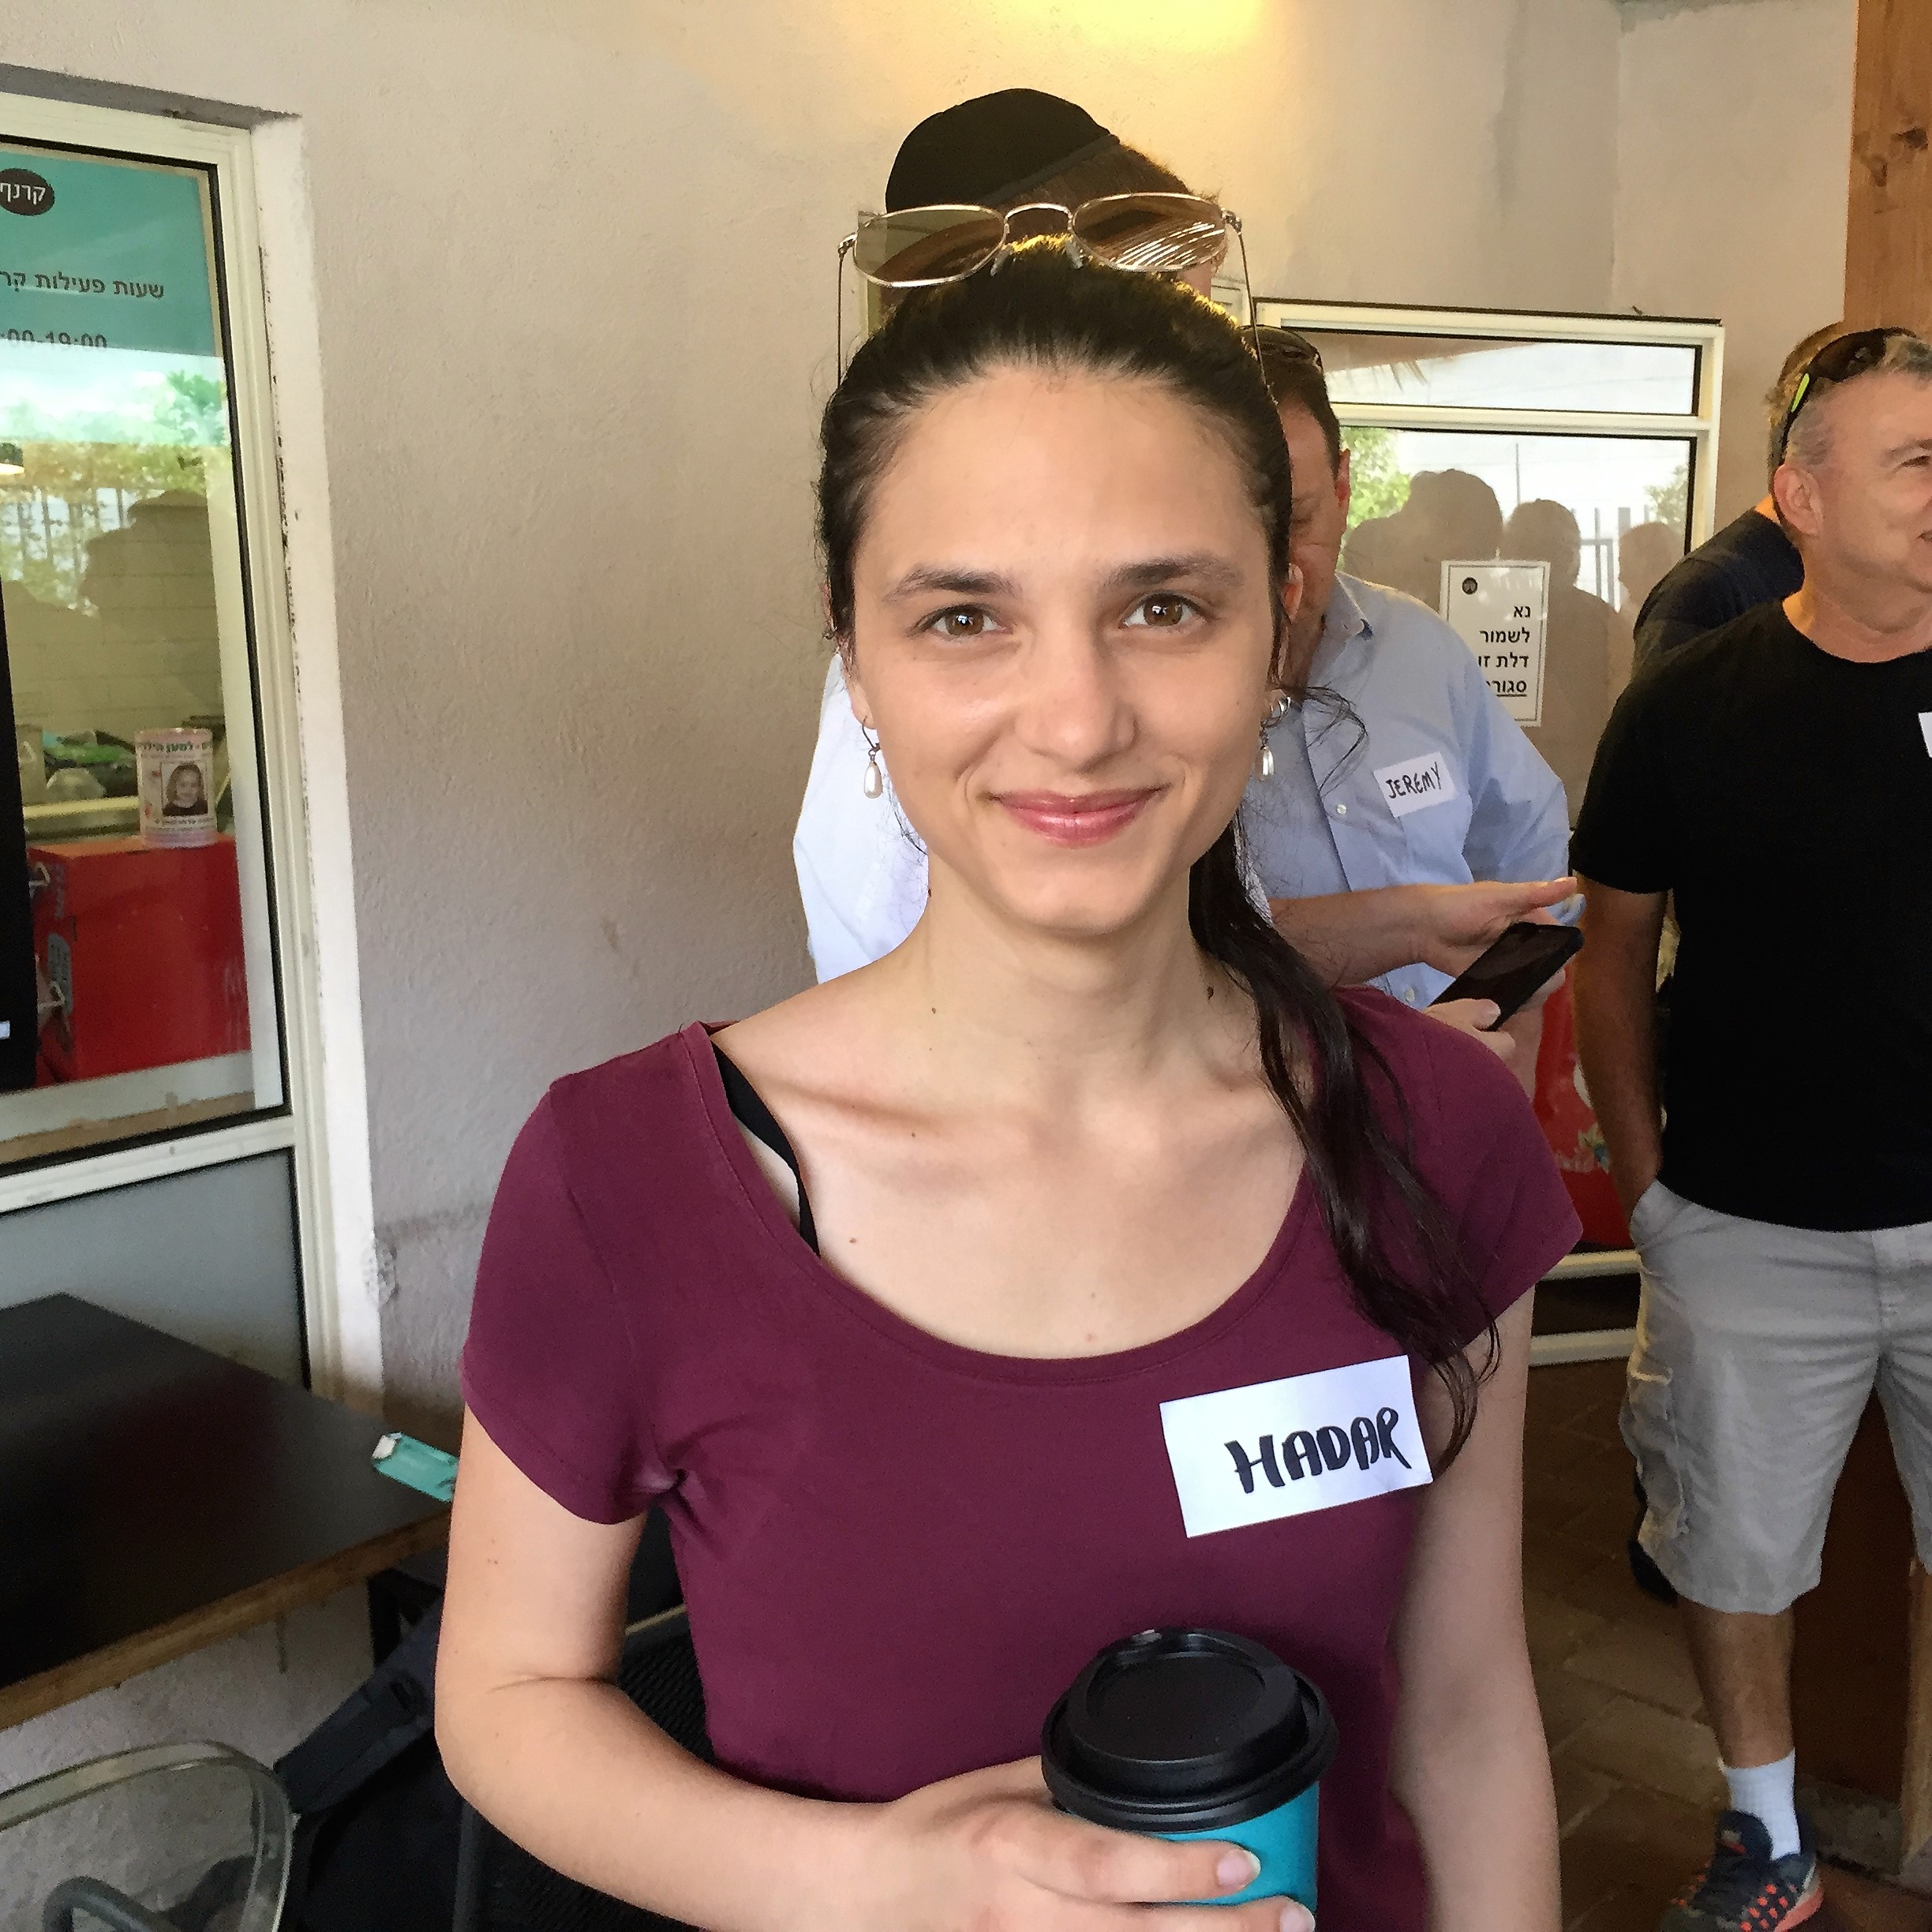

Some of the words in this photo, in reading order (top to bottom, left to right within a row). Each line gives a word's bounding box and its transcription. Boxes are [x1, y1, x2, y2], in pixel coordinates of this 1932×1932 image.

[0, 182, 46, 205] קרנף
[35, 271, 106, 294] פעילות
[113, 279, 164, 299] שעות
[1513, 605, 1532, 619] נא
[1479, 627, 1531, 643] לשמור
[1477, 655, 1491, 668] זו
[1496, 651, 1530, 668] דלת
[1385, 761, 1442, 799] JEREMY
[1223, 1406, 1413, 1494] HADAR
